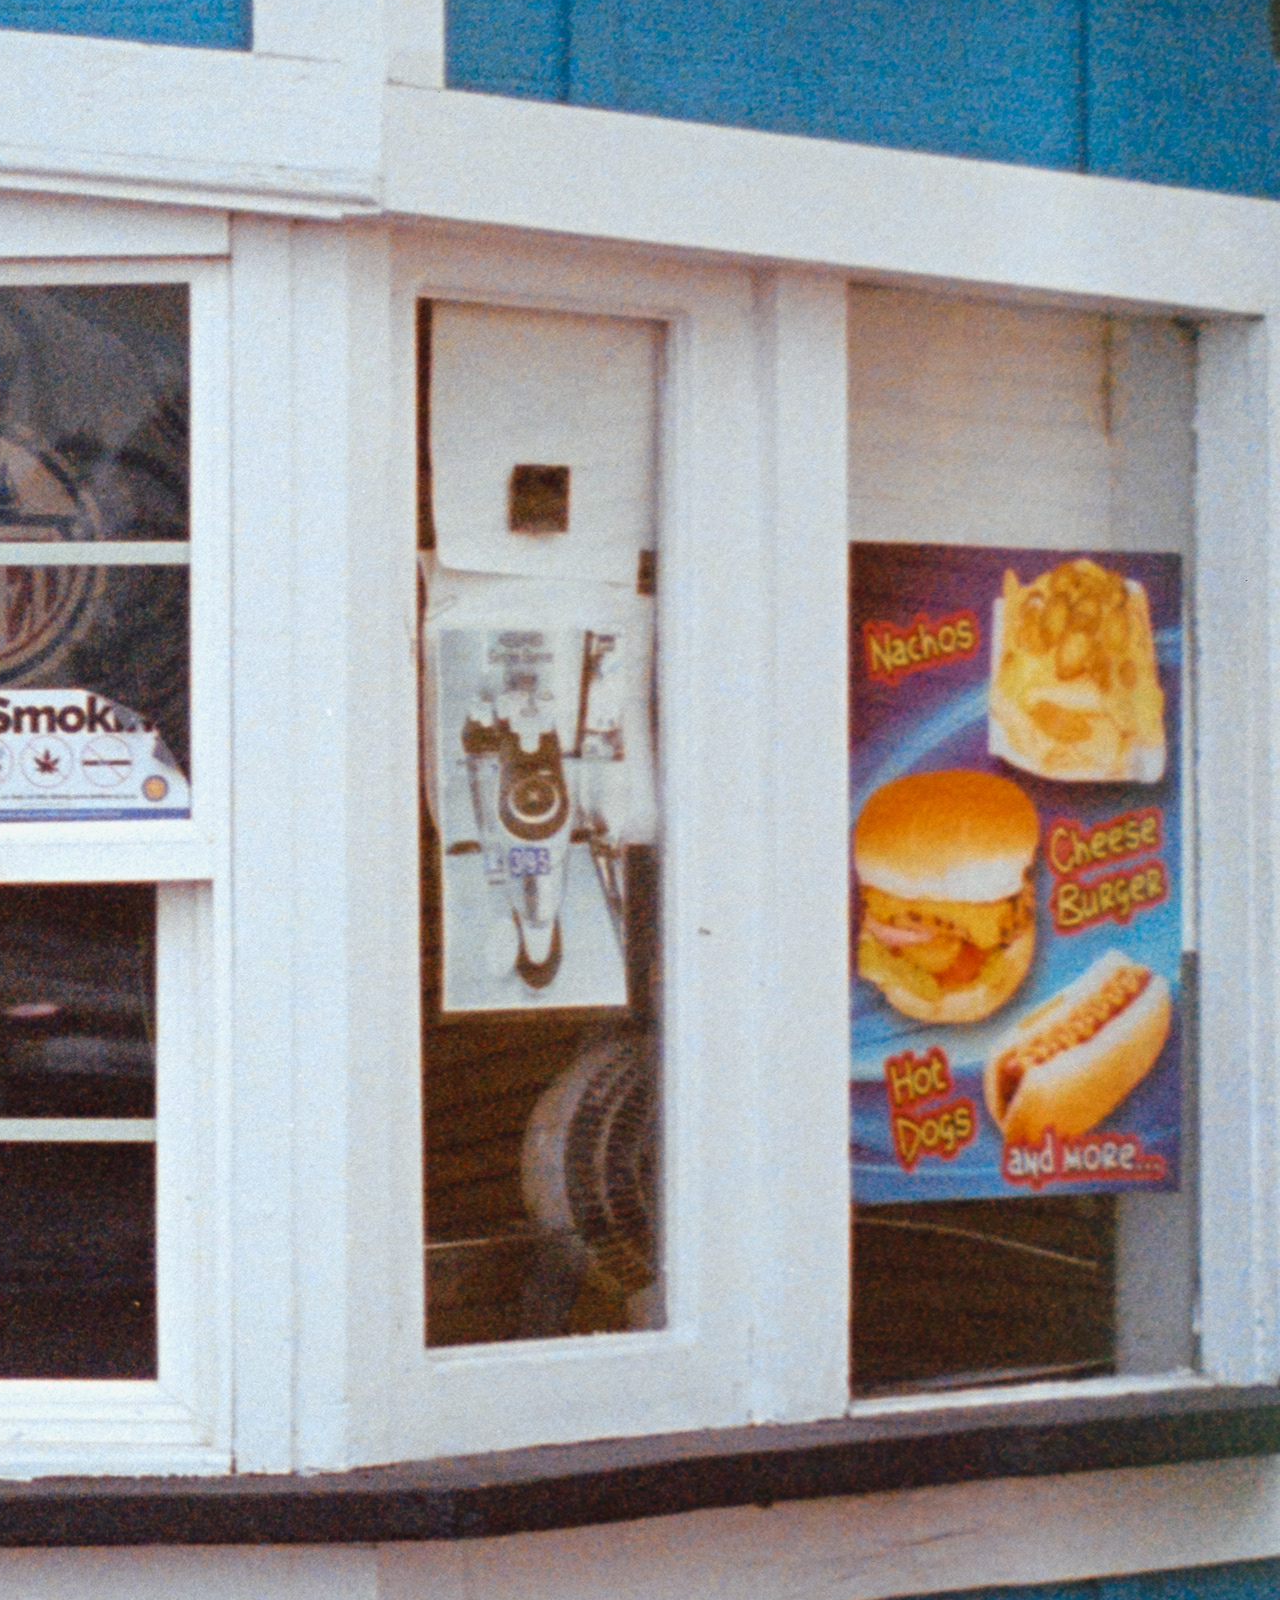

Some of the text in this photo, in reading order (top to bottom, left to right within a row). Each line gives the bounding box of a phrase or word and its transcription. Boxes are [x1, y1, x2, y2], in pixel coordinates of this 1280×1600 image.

[870, 619, 974, 673] Nachos
[1049, 816, 1158, 873] Cheese
[1057, 867, 1162, 926] Burger
[889, 1058, 947, 1105] Hot
[896, 1107, 972, 1164] Dogs
[1006, 1132, 1055, 1178] and
